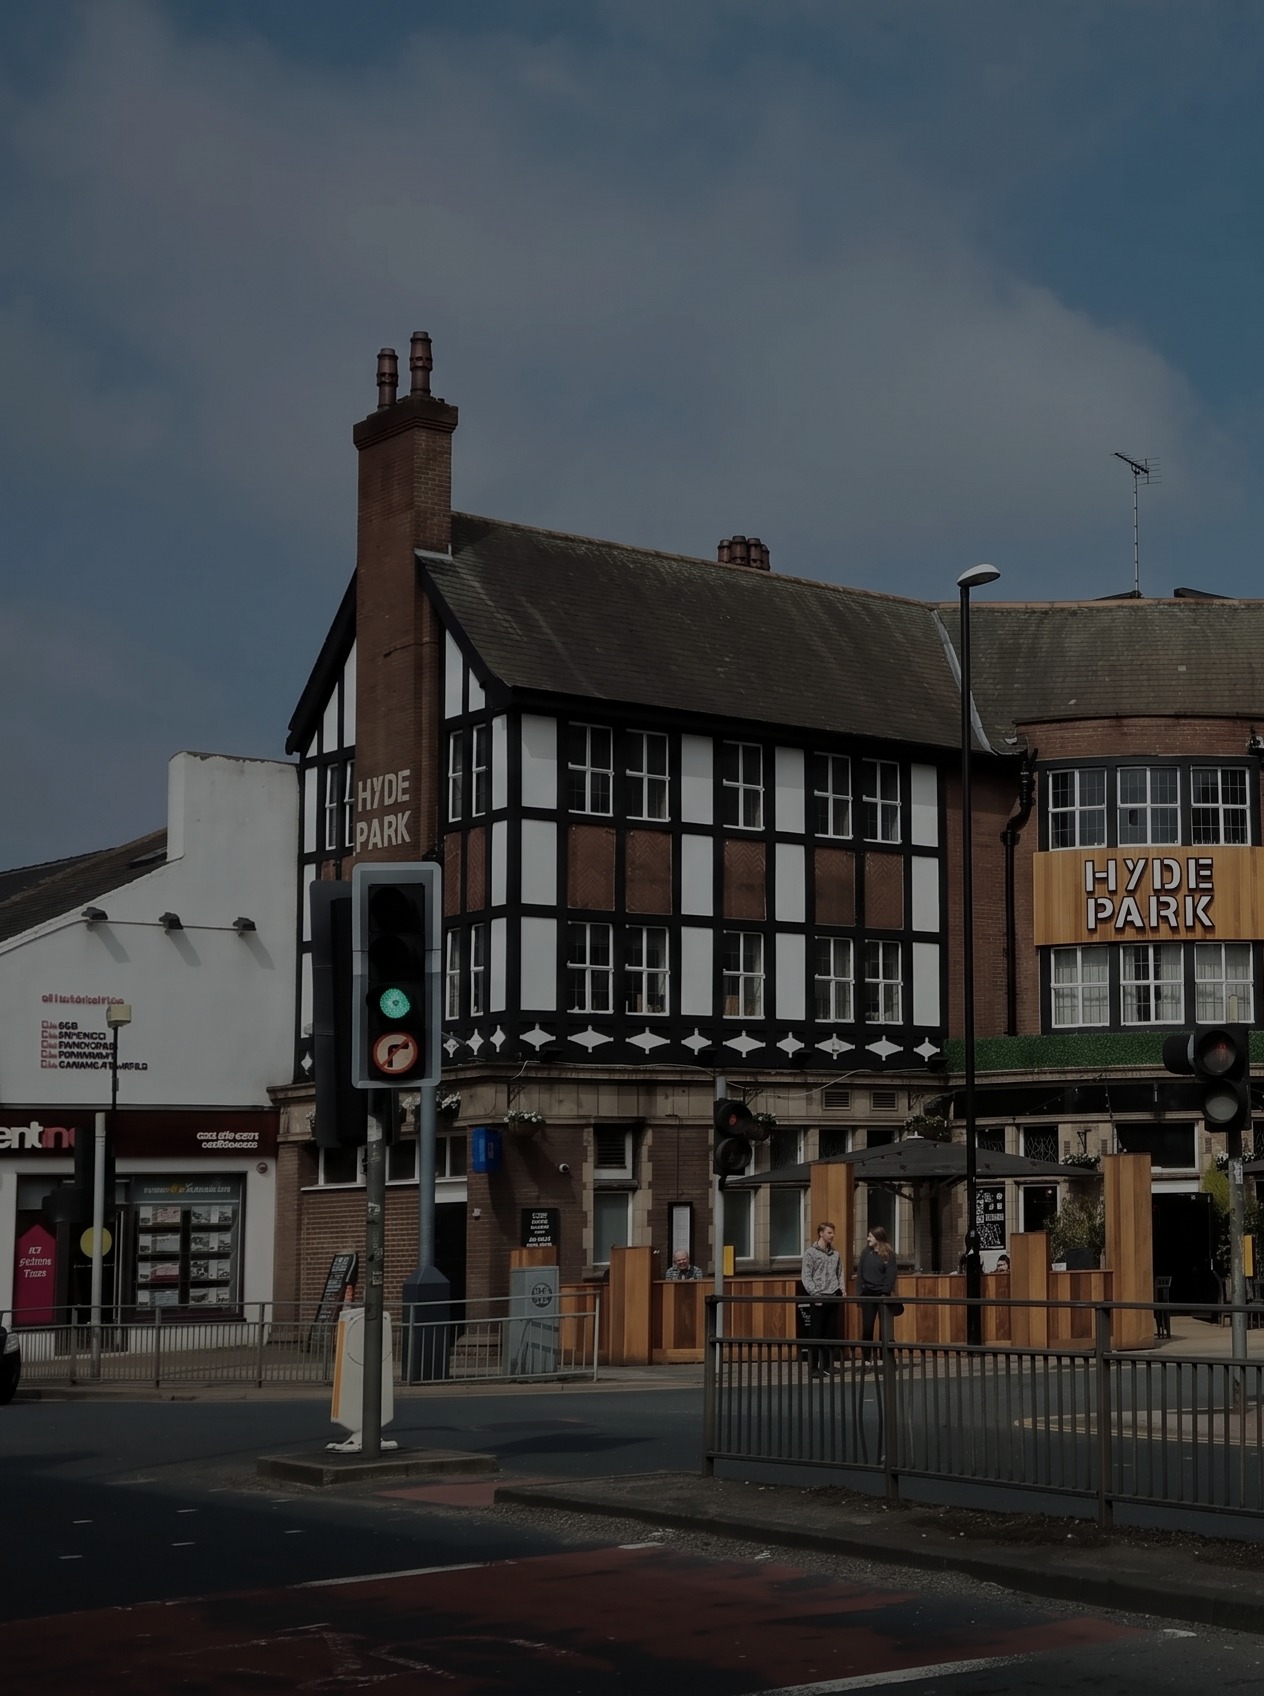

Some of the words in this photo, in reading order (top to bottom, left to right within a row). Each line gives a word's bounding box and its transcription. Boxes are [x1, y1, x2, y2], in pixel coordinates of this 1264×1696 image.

[357, 769, 411, 812] HYDE
[355, 810, 412, 853] PARK
[1085, 857, 1213, 892] HYDE
[1087, 895, 1215, 930] PARK
